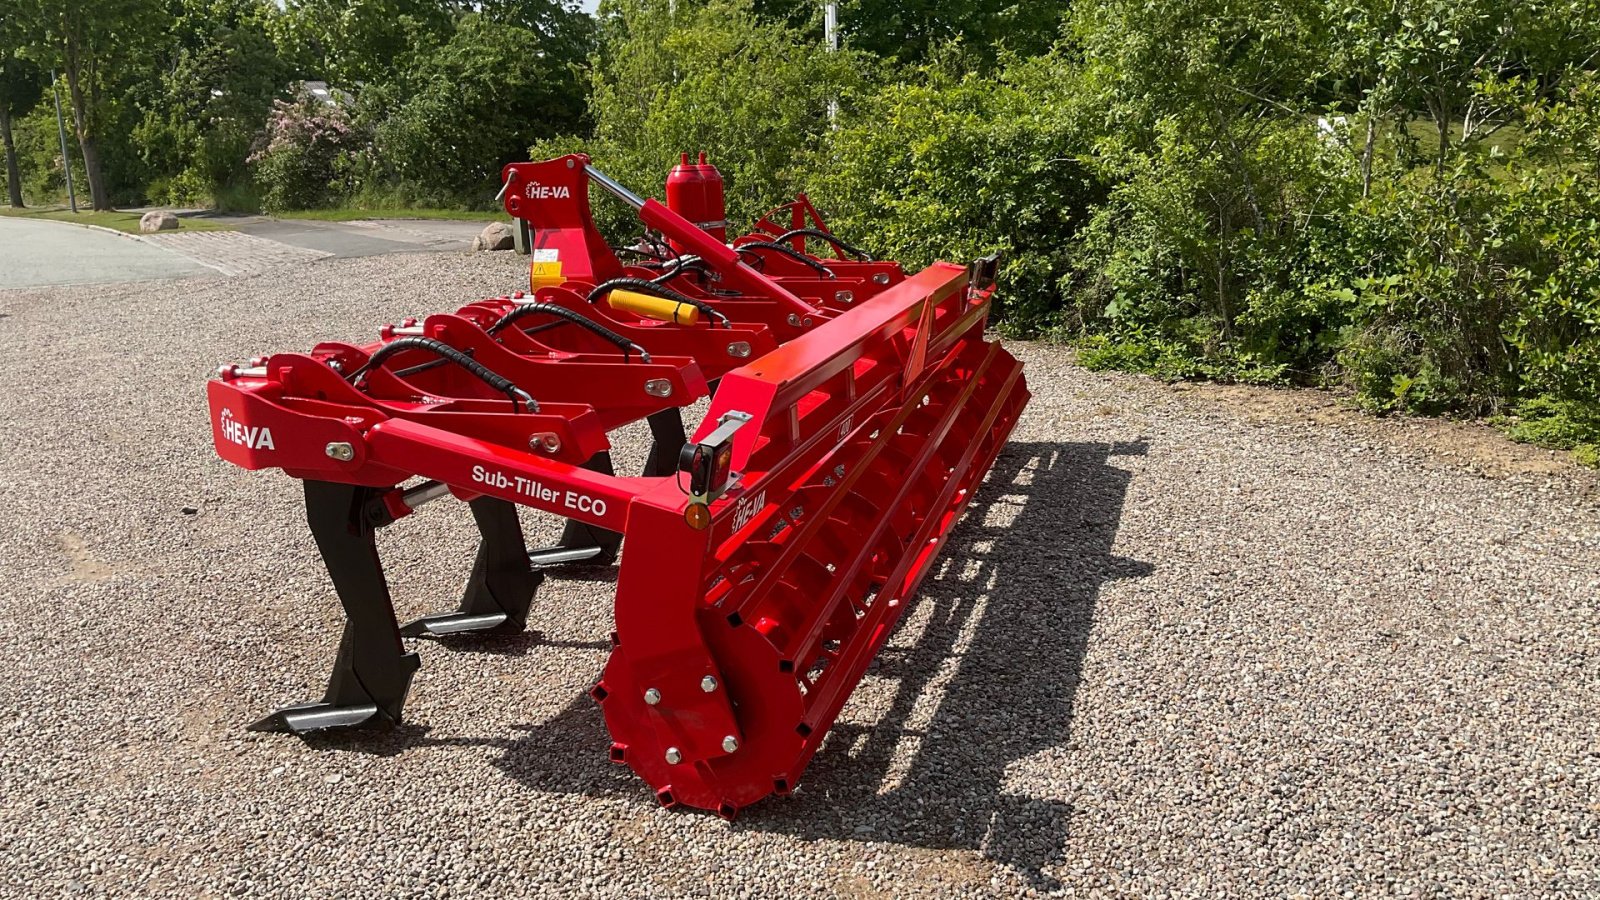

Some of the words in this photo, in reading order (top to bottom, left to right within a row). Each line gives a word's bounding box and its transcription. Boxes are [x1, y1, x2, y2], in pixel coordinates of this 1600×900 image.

[530, 186, 570, 199] HE-VA
[224, 419, 275, 450] HE-VA
[472, 465, 560, 503] Sub-Tiller
[564, 490, 607, 516] ECO
[735, 490, 766, 532] HE-VA
